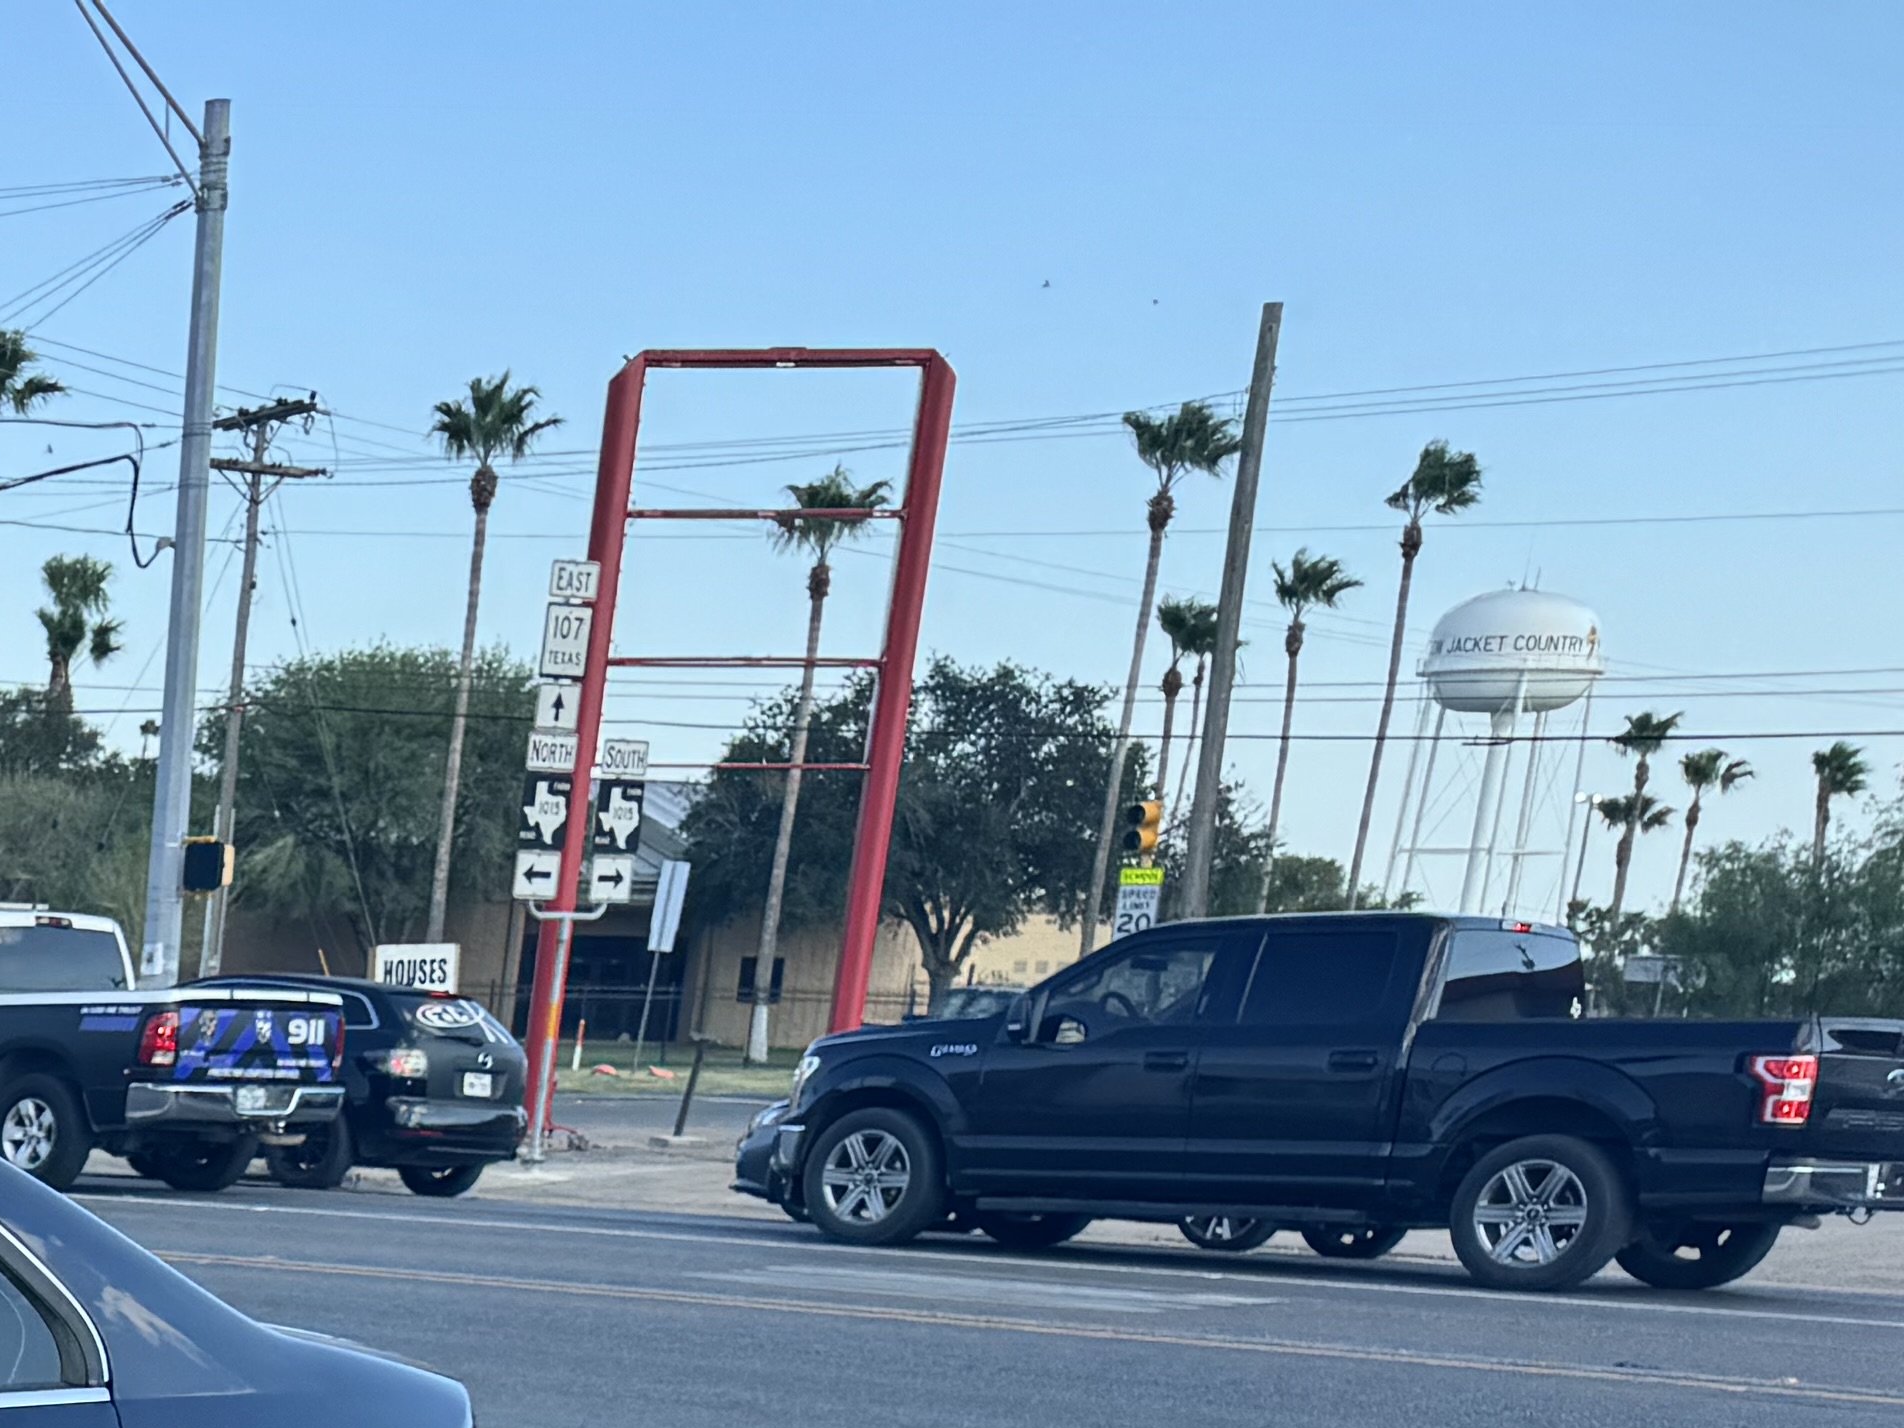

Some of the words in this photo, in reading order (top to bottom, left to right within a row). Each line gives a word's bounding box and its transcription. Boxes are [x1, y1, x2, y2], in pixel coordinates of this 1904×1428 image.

[556, 567, 592, 593] EAST
[553, 615, 585, 640] 107
[1446, 635, 1508, 653] JACKET
[1513, 634, 1584, 653] COUNTRY
[548, 650, 582, 667] TEXAS
[532, 739, 573, 763] NORTH
[605, 745, 645, 769] SOUTH
[1122, 889, 1156, 899] SPEED
[1117, 913, 1151, 933] 20
[382, 959, 448, 986] HOUSES
[287, 1018, 325, 1046] 911
